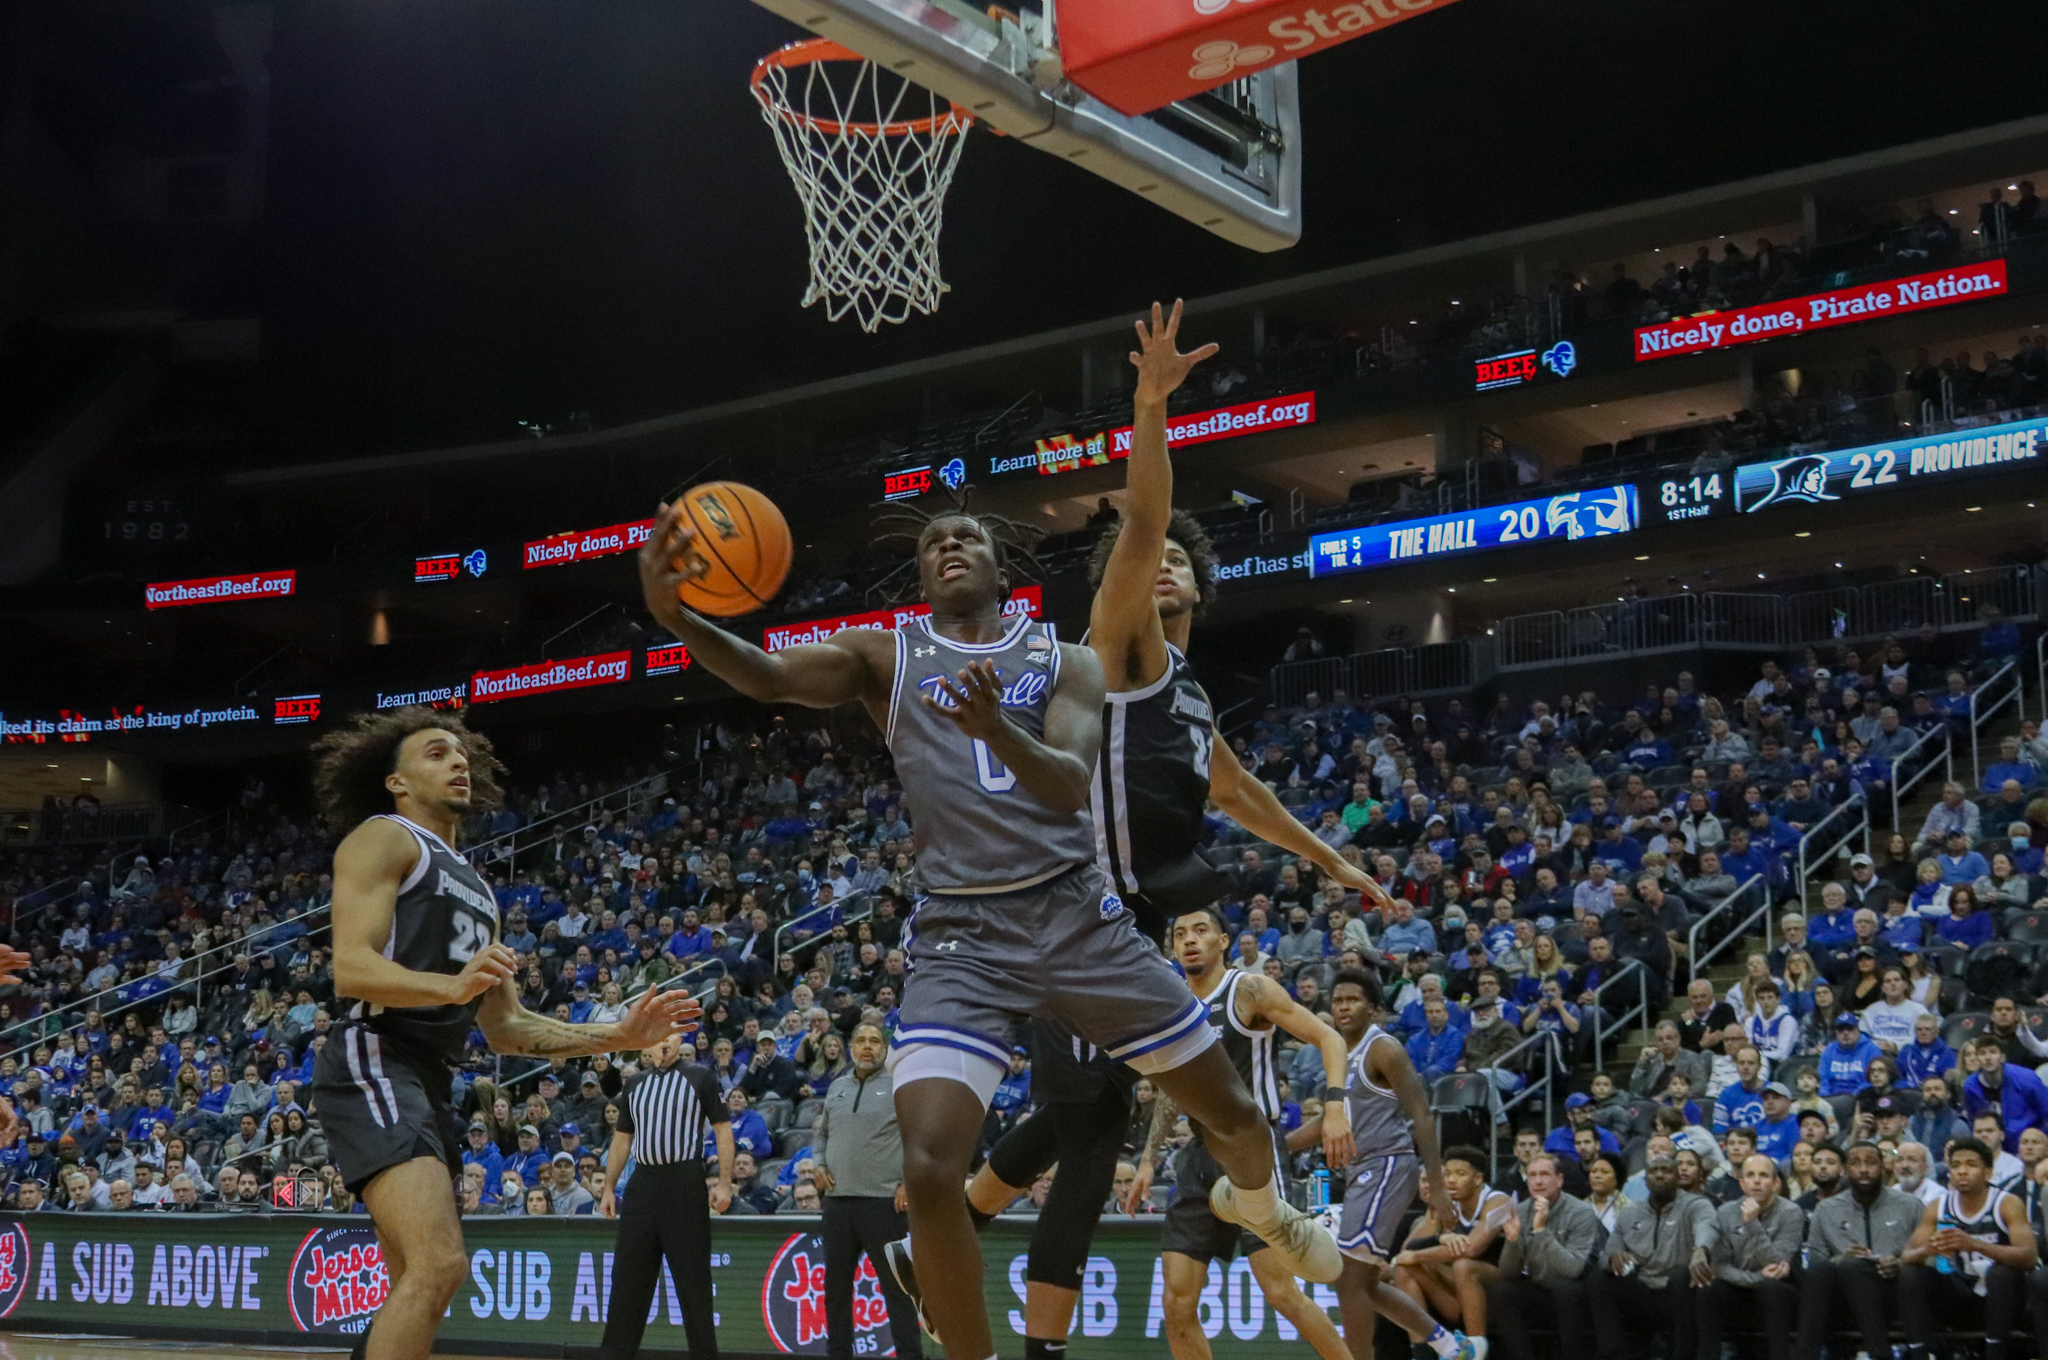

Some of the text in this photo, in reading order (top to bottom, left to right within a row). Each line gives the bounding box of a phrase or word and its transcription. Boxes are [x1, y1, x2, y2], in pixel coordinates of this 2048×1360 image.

[1640, 272, 2001, 354] Nicely done, Pirate Nation.
[1475, 354, 1536, 383] BEEF
[990, 454, 1037, 474] Learn
[1040, 445, 1083, 464] more
[1086, 440, 1103, 455] at
[1849, 429, 2039, 489] 22 PROVIDENCE
[884, 470, 931, 494] BEEF
[1661, 473, 1723, 507] 8:14
[1667, 504, 1711, 520] 1ST Half
[104, 521, 190, 540] 1982
[1389, 507, 1540, 560] THE HALL 20
[527, 540, 578, 564] Nicely
[581, 534, 624, 553] done,
[1320, 536, 1361, 556] FOULS 5
[1352, 552, 1362, 566] 4
[415, 558, 460, 576] BEEF
[1254, 556, 1288, 574] has
[146, 577, 292, 603] NortheastBeef.org
[646, 646, 691, 669] BEEF
[376, 691, 415, 709] Learn
[418, 688, 451, 703] more
[454, 683, 466, 697] at
[475, 660, 627, 696] NortheastBeef.org
[35, 720, 55, 734] its
[58, 718, 103, 733] claim
[105, 719, 120, 731] as
[122, 714, 144, 729] the
[147, 712, 181, 729] king
[184, 709, 200, 724] of
[201, 705, 259, 727] protein.
[275, 699, 321, 717] BEEF
[37, 1242, 57, 1301] A
[71, 1241, 134, 1303] SUB
[470, 1248, 552, 1320] SUB
